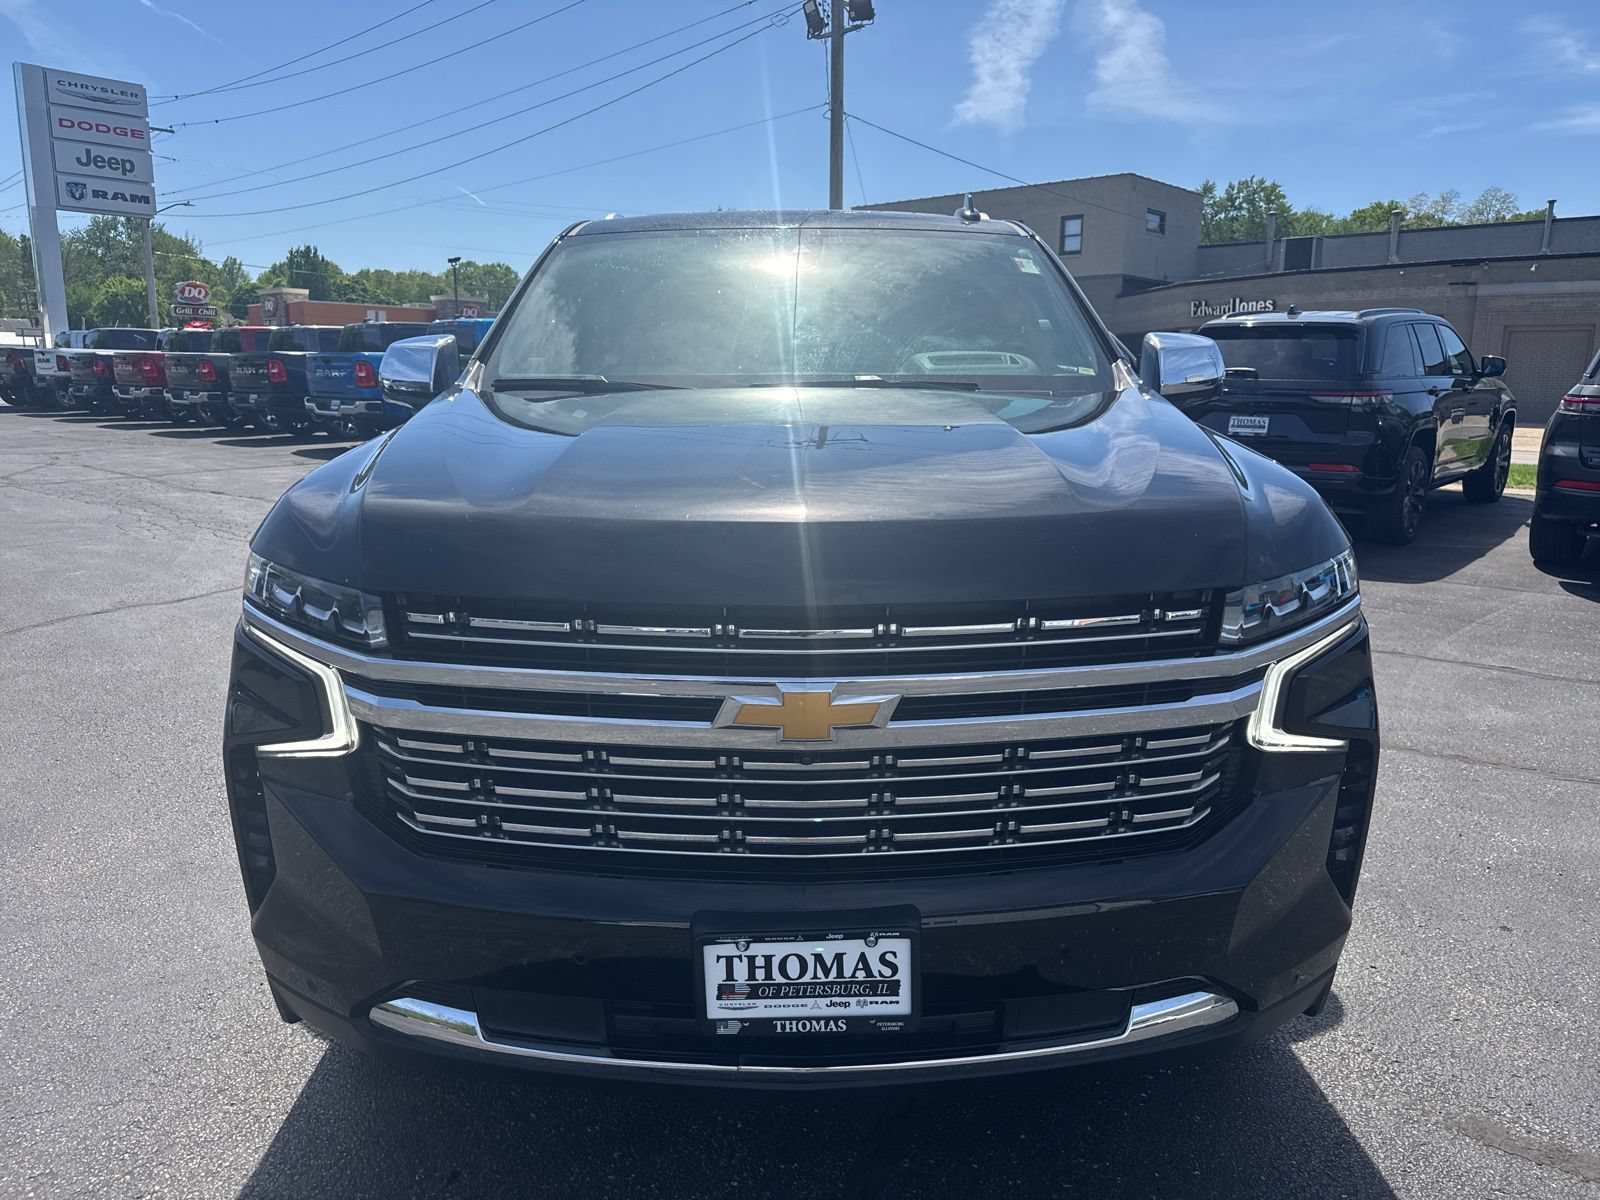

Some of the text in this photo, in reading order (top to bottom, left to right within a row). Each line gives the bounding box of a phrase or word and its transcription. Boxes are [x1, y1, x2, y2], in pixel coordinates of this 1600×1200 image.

[57, 80, 139, 99] CHRYSLER
[58, 118, 145, 139] DODGE
[75, 148, 136, 176] Jeep
[91, 189, 151, 205] RAM
[184, 286, 206, 300] DQ
[176, 307, 216, 316] Grill Chill
[463, 307, 478, 318] DQ
[1191, 298, 1274, 317] Edward Jones
[716, 950, 899, 982] THOMAS
[758, 984, 891, 997] OF PETERSBURG, IL
[825, 999, 851, 1009] Jeep
[773, 1019, 847, 1033] THOMAS
